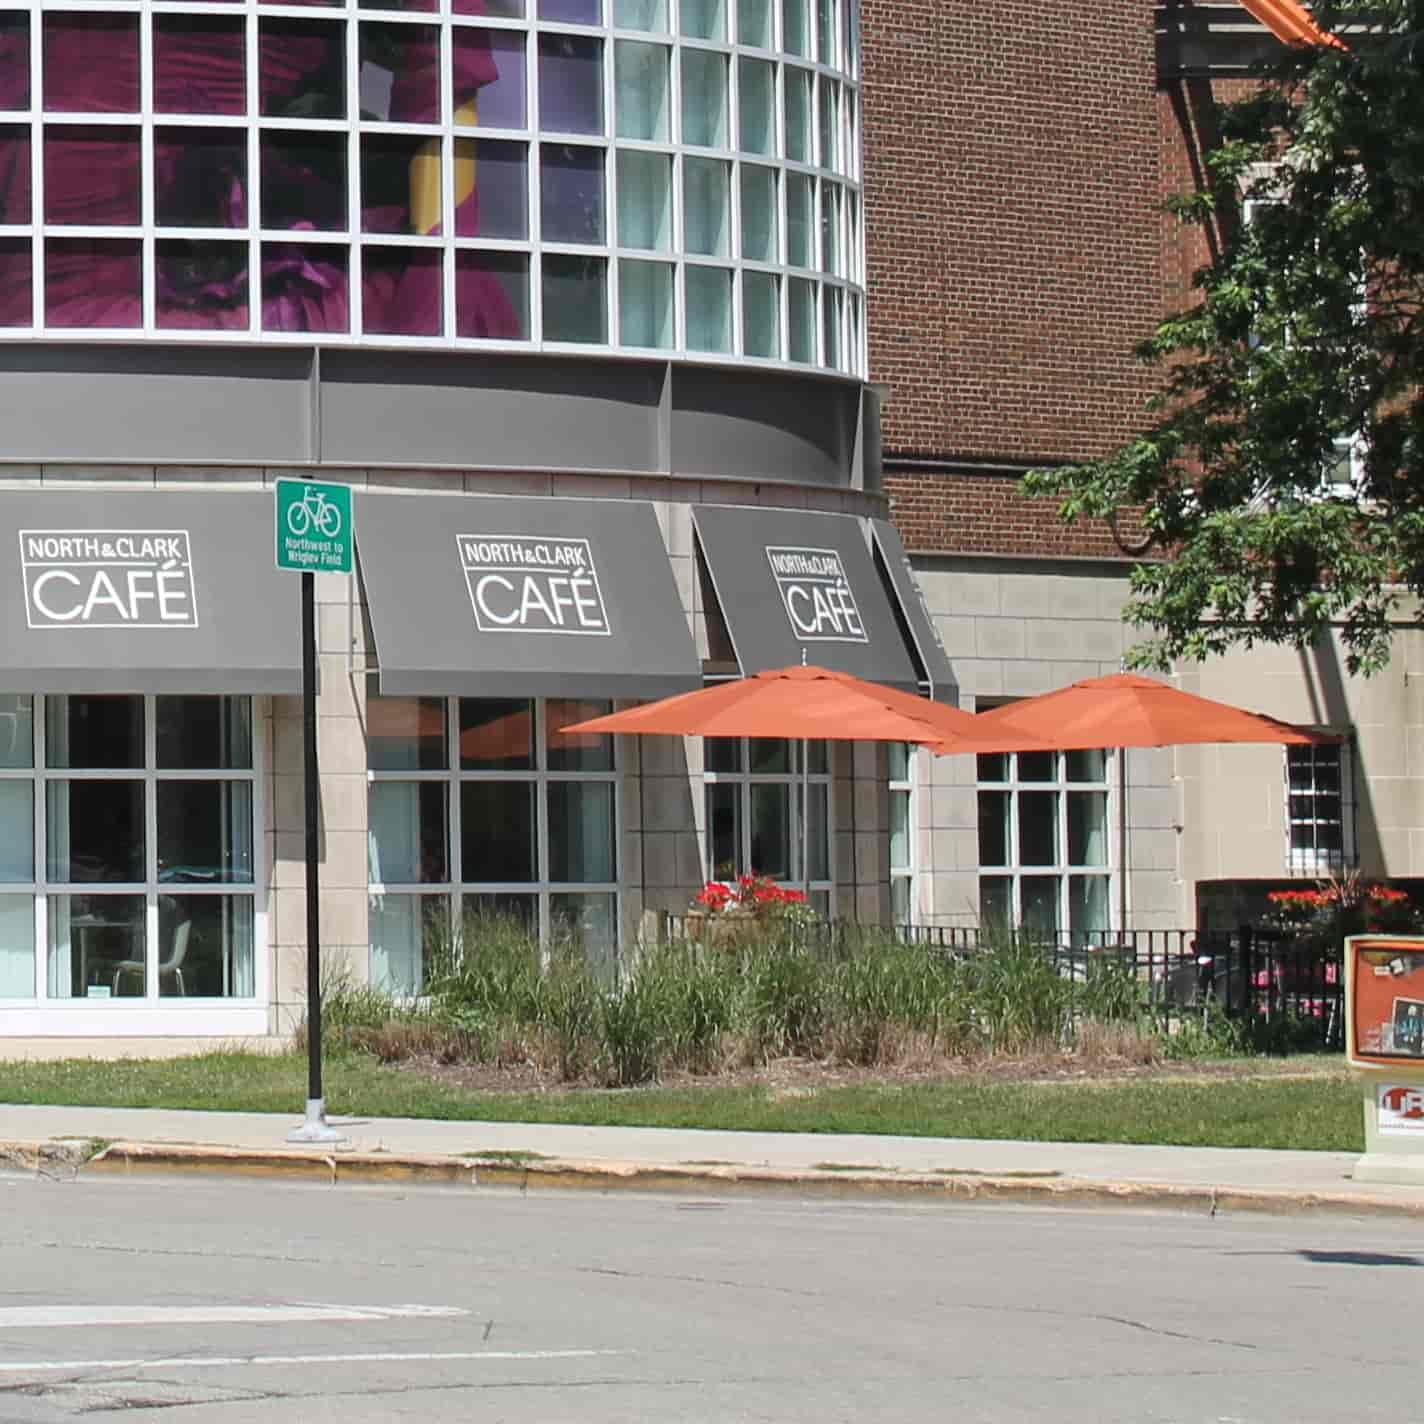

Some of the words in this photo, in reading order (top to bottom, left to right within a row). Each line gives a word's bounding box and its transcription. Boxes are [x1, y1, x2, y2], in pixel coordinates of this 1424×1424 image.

[286, 536, 331, 552] Northwest
[334, 542, 344, 553] to
[288, 550, 319, 566] Wrigley
[321, 552, 342, 566] Field
[32, 559, 189, 620] CAFÉ
[476, 567, 603, 625] CAFÉ
[787, 577, 863, 634] CAFÉ
